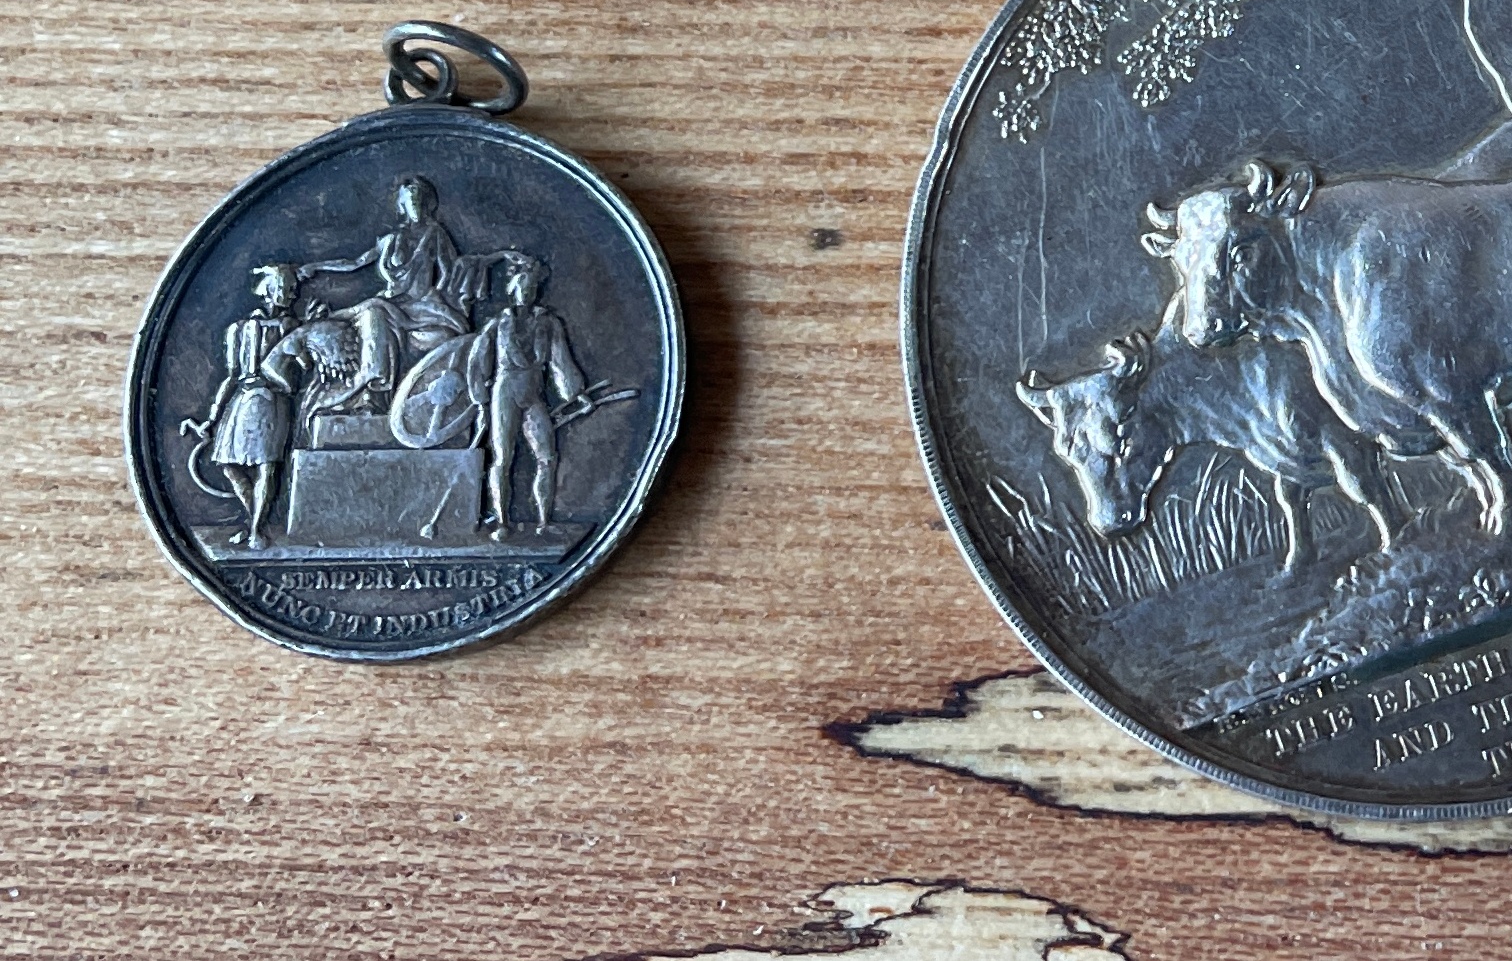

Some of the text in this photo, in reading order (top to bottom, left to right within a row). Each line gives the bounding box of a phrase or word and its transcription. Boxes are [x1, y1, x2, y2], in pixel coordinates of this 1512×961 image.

[280, 564, 499, 591] SEMPER ARMIS
[1265, 702, 1354, 757] THE
[1367, 648, 1509, 723] EARTH
[1372, 718, 1456, 772] AND
